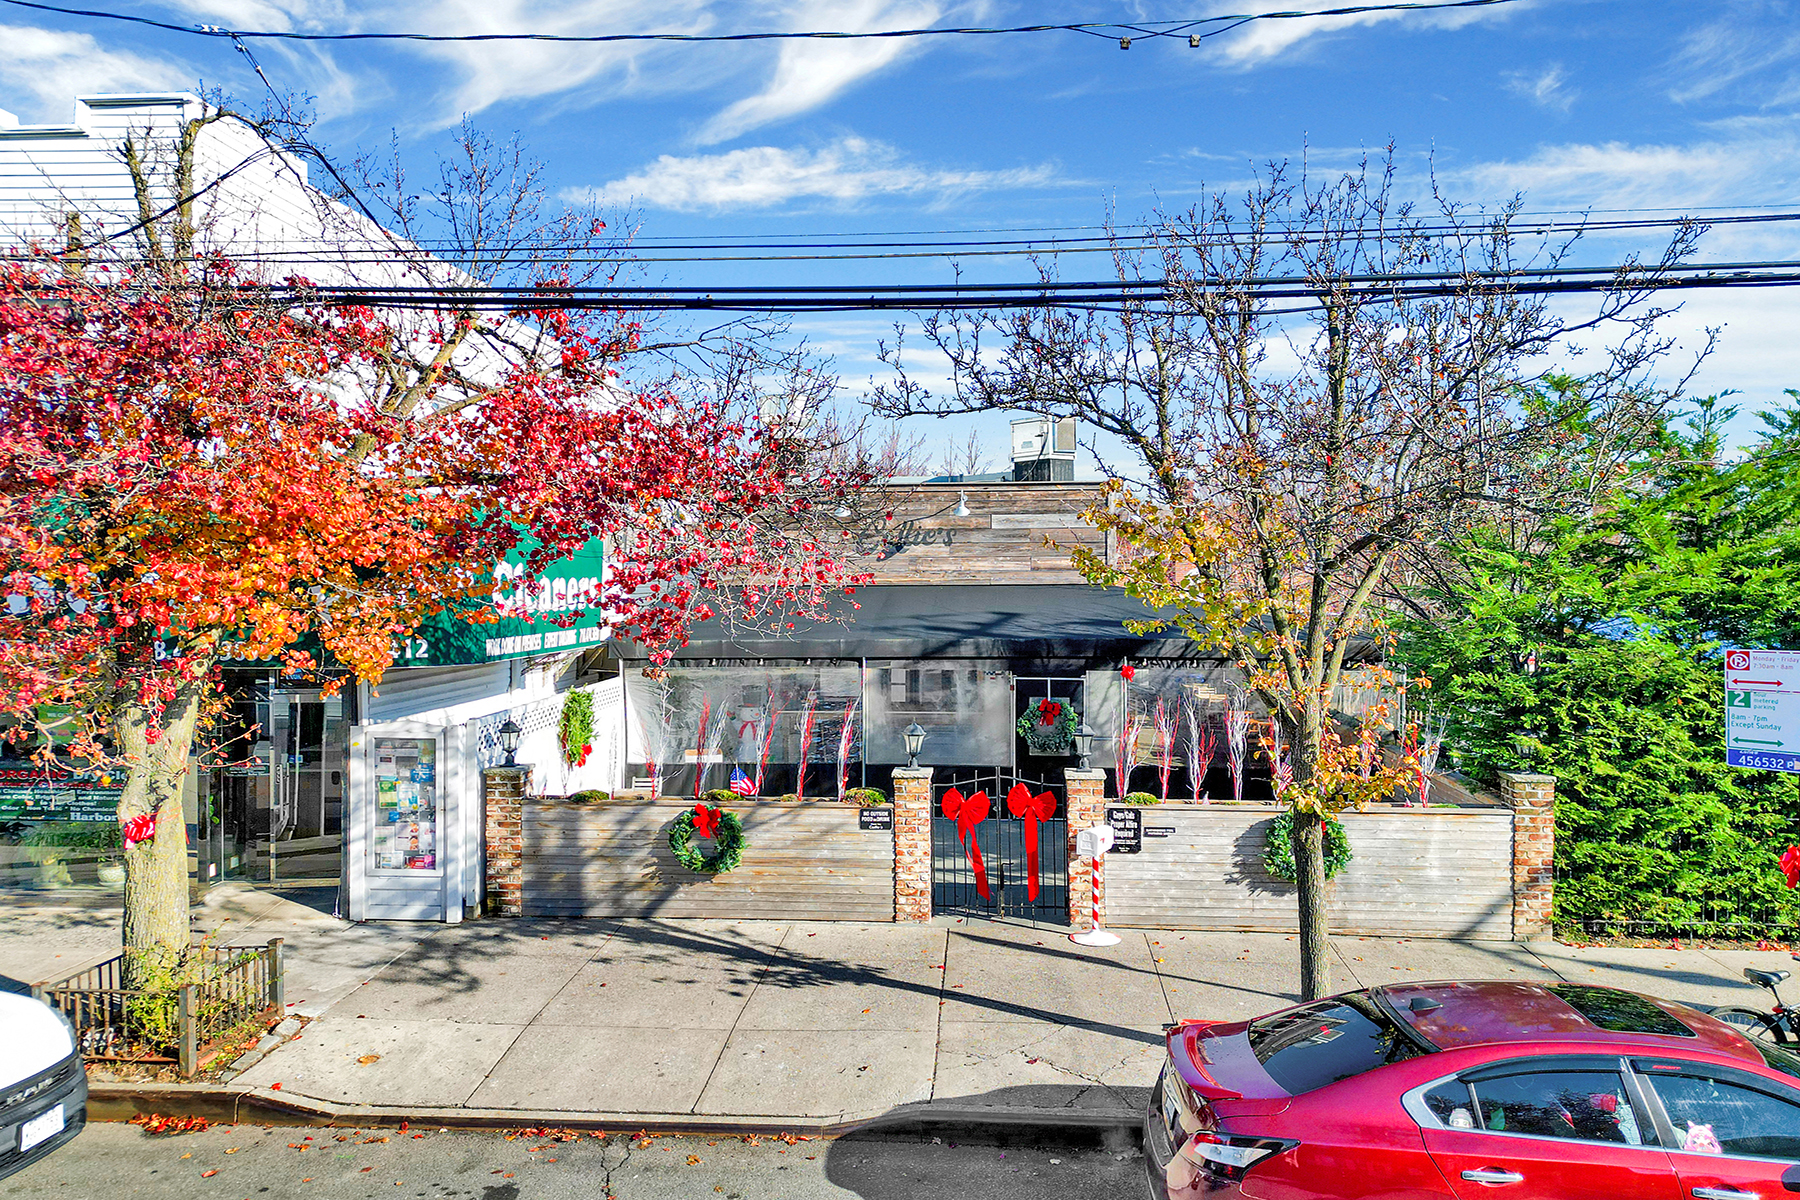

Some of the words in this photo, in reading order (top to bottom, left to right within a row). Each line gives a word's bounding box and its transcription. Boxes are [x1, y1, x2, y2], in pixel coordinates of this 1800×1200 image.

[1753, 655, 1775, 663] Monday
[1781, 656, 1800, 664] Friday
[1733, 691, 1745, 706] 2
[1753, 704, 1776, 712] parking
[1731, 721, 1754, 730] Except
[1756, 722, 1782, 732] Sunday
[1738, 755, 1784, 769] 456532
[73, 770, 98, 782] Dry
[70, 812, 118, 821] Harbor
[6, 1077, 53, 1105] RAM
